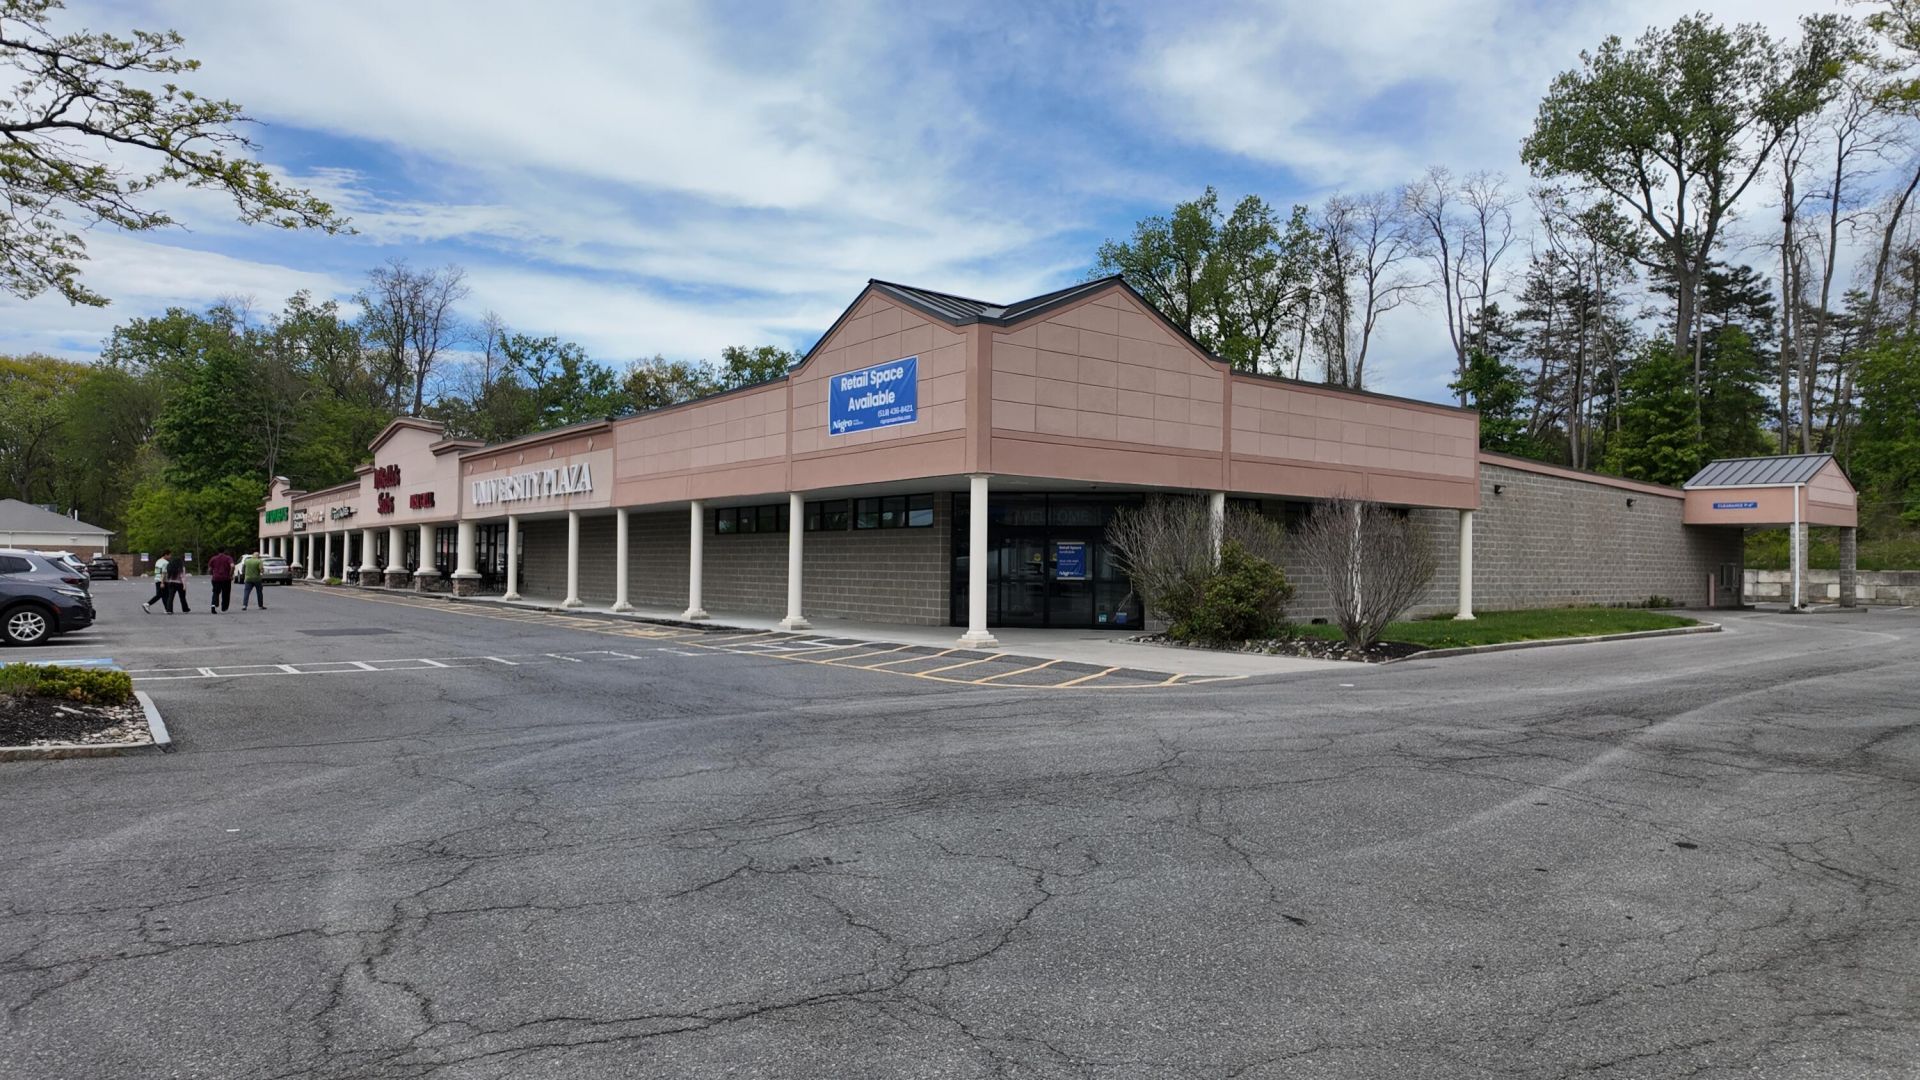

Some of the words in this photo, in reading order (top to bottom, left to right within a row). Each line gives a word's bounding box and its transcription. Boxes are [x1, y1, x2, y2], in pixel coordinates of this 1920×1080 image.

[840, 371, 868, 392] Retail
[870, 366, 904, 388] Space
[848, 389, 896, 412] Available
[832, 419, 853, 432] Nigro
[472, 472, 544, 505] UNIVERSITY
[544, 462, 593, 496] PLAZA
